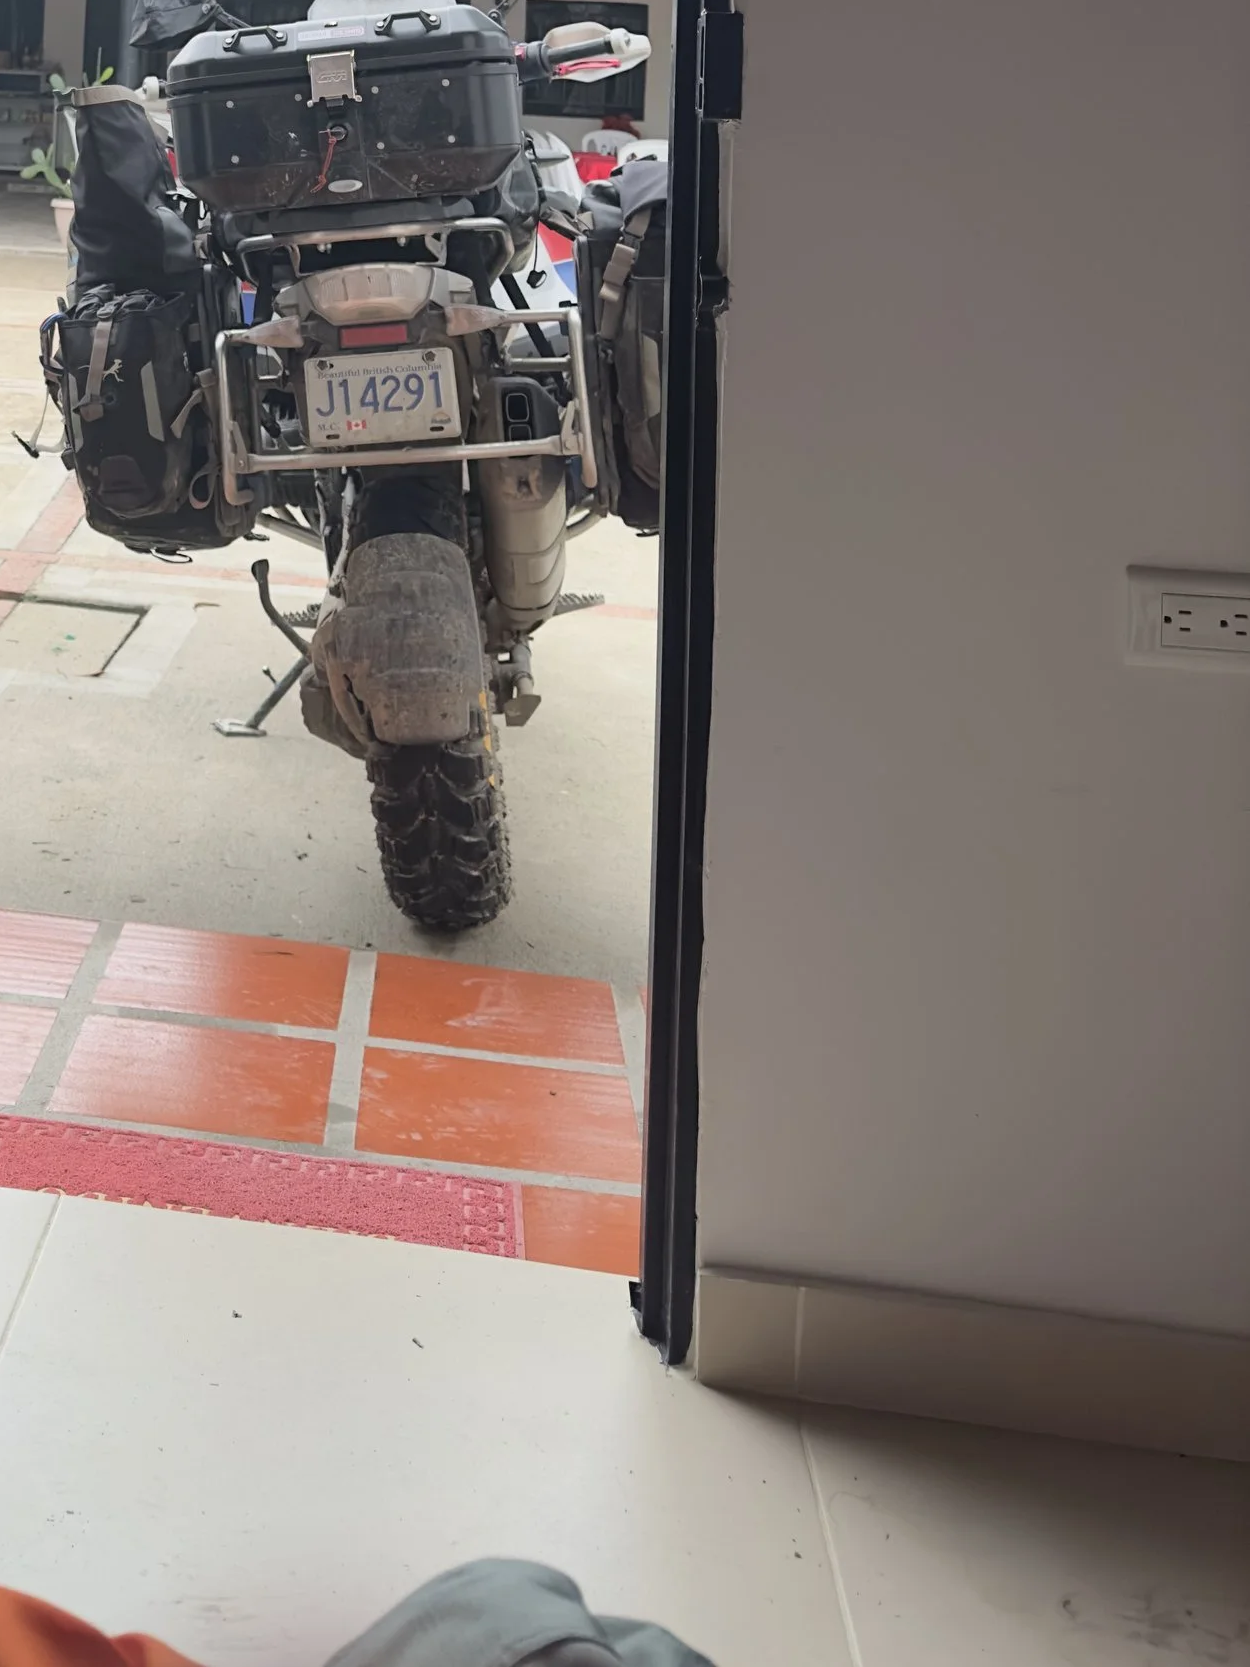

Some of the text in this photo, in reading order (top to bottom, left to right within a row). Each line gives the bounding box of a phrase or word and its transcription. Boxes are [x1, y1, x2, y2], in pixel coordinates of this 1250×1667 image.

[317, 362, 442, 380] Beautiful British Columbia
[316, 371, 443, 417] J14291
